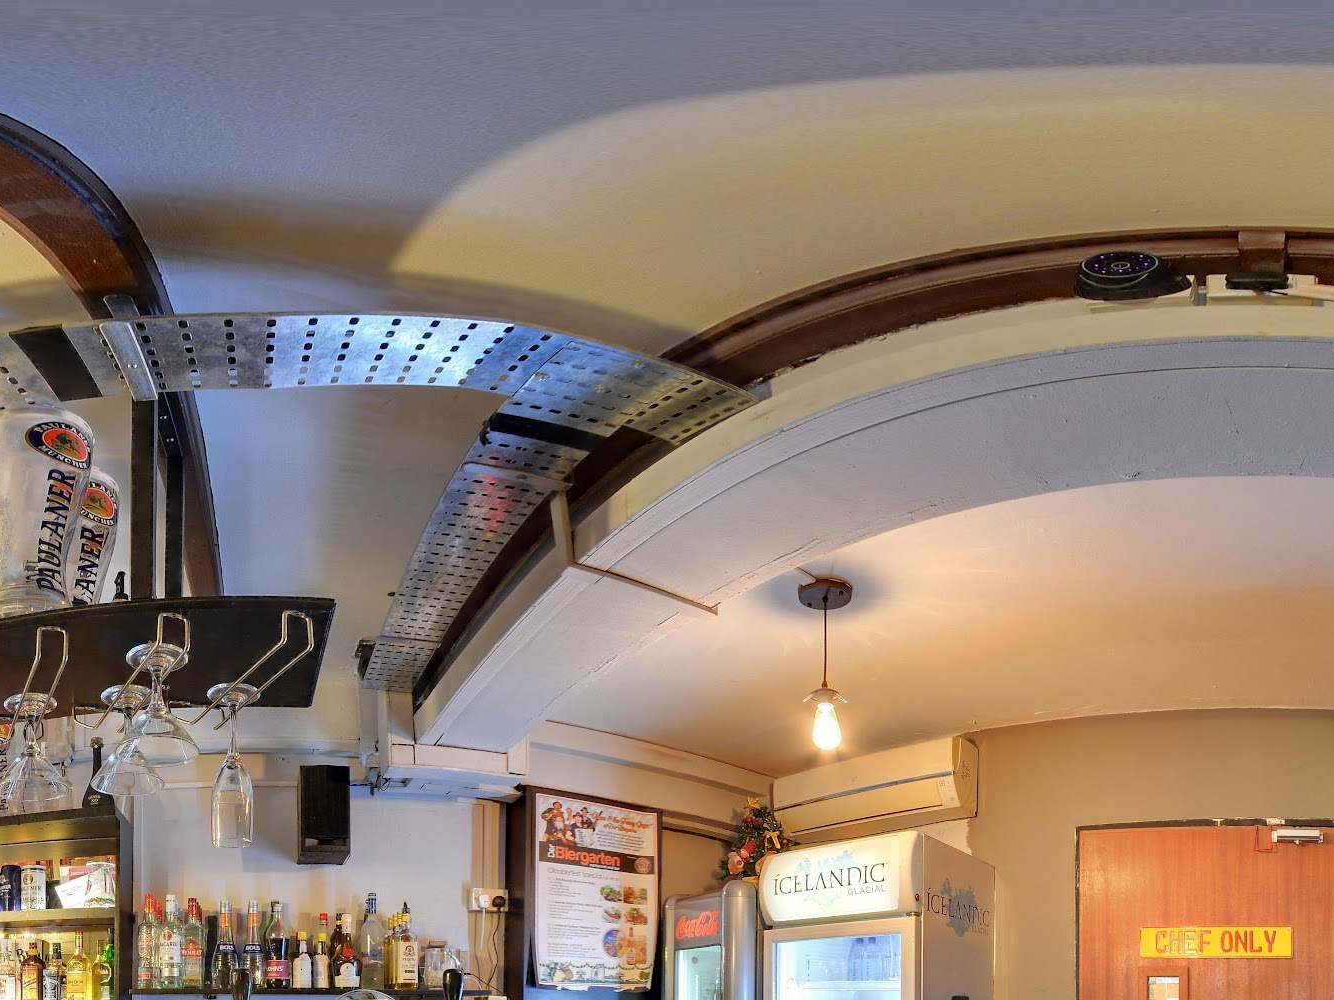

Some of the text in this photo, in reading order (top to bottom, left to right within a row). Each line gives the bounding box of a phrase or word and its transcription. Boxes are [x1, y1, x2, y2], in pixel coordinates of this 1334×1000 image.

[37, 468, 76, 597] PAULANER
[555, 845, 620, 867] Biergarten
[547, 866, 581, 877] Oktoberfest
[582, 871, 603, 879] Special
[847, 884, 887, 896] GLACIAL
[675, 910, 719, 940] Coca-Cola
[971, 924, 989, 936] GLACIAL
[1156, 930, 1277, 954] CHEF ONLY
